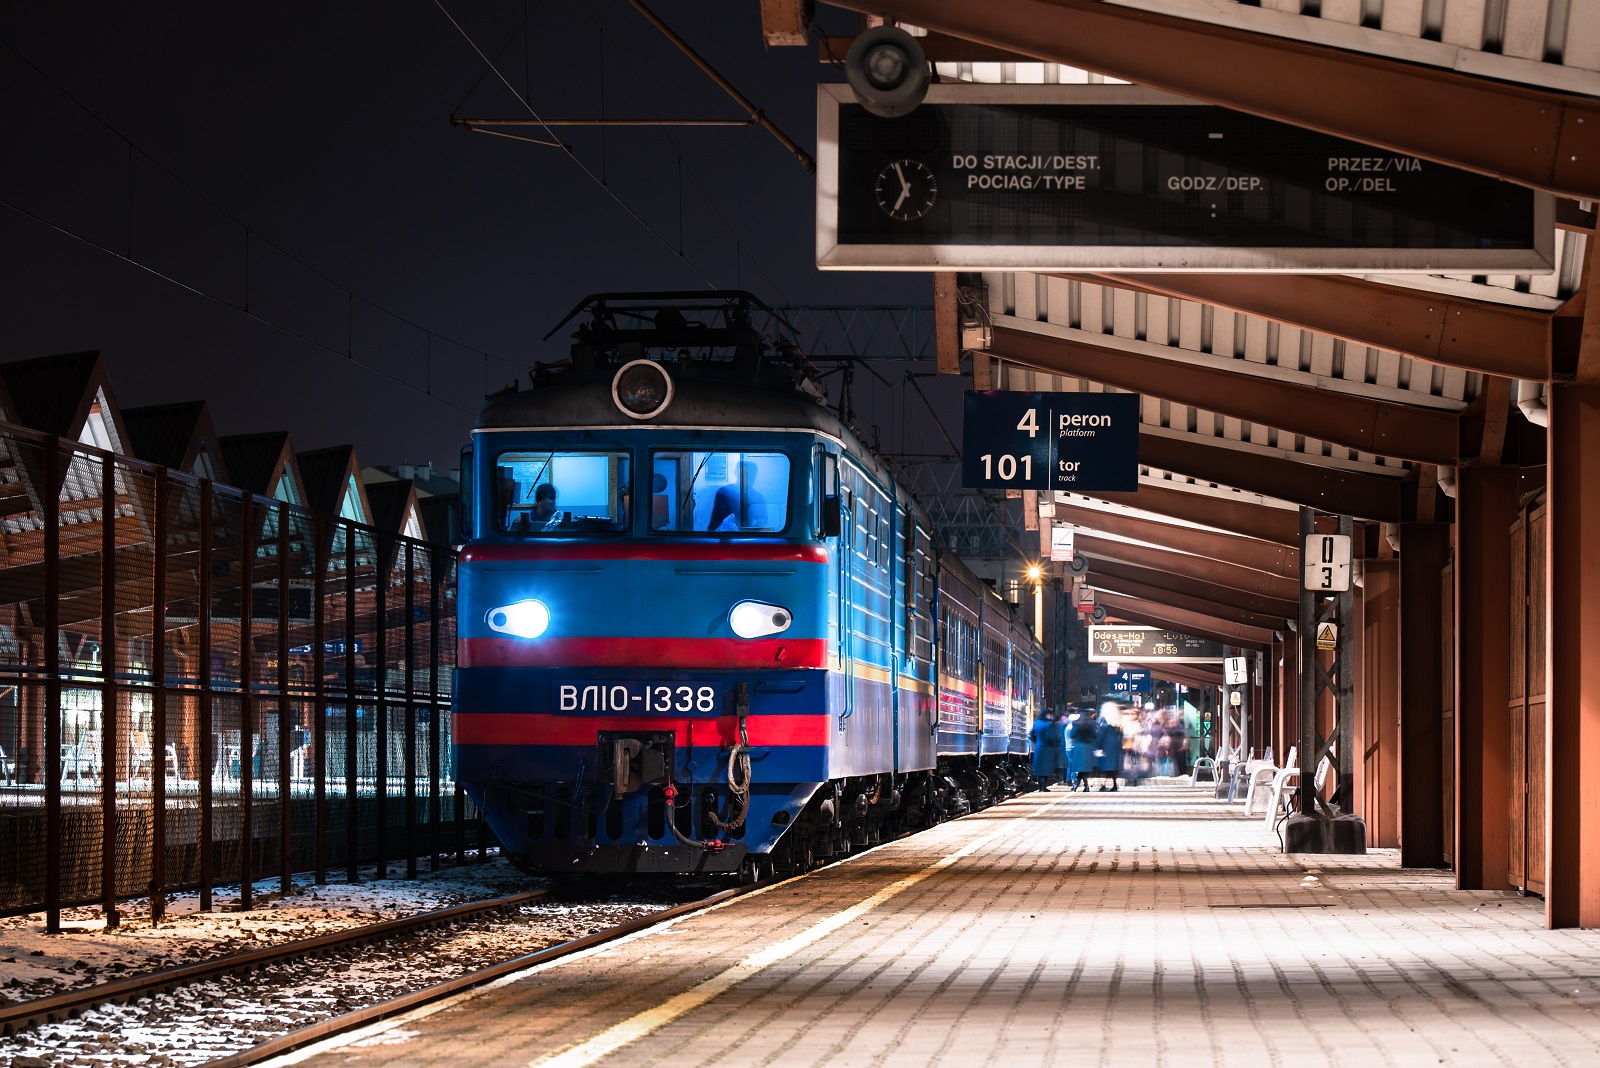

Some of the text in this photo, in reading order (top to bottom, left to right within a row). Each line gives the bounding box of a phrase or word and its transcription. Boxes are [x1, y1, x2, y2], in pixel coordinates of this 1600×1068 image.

[953, 155, 1101, 169] DO STACJI/DEST.
[1328, 157, 1422, 172] PRZEZ/VIA
[1167, 176, 1264, 191] GODZ/DEP.
[1325, 177, 1397, 191] OP./DEL
[1016, 408, 1111, 438] 4 peron
[1059, 429, 1096, 438] platform
[980, 454, 1081, 481] 101 tor
[1058, 474, 1077, 482] track
[1321, 567, 1332, 588] 3
[1117, 646, 1178, 655] TLK 18:59
[1122, 672, 1129, 680] 4
